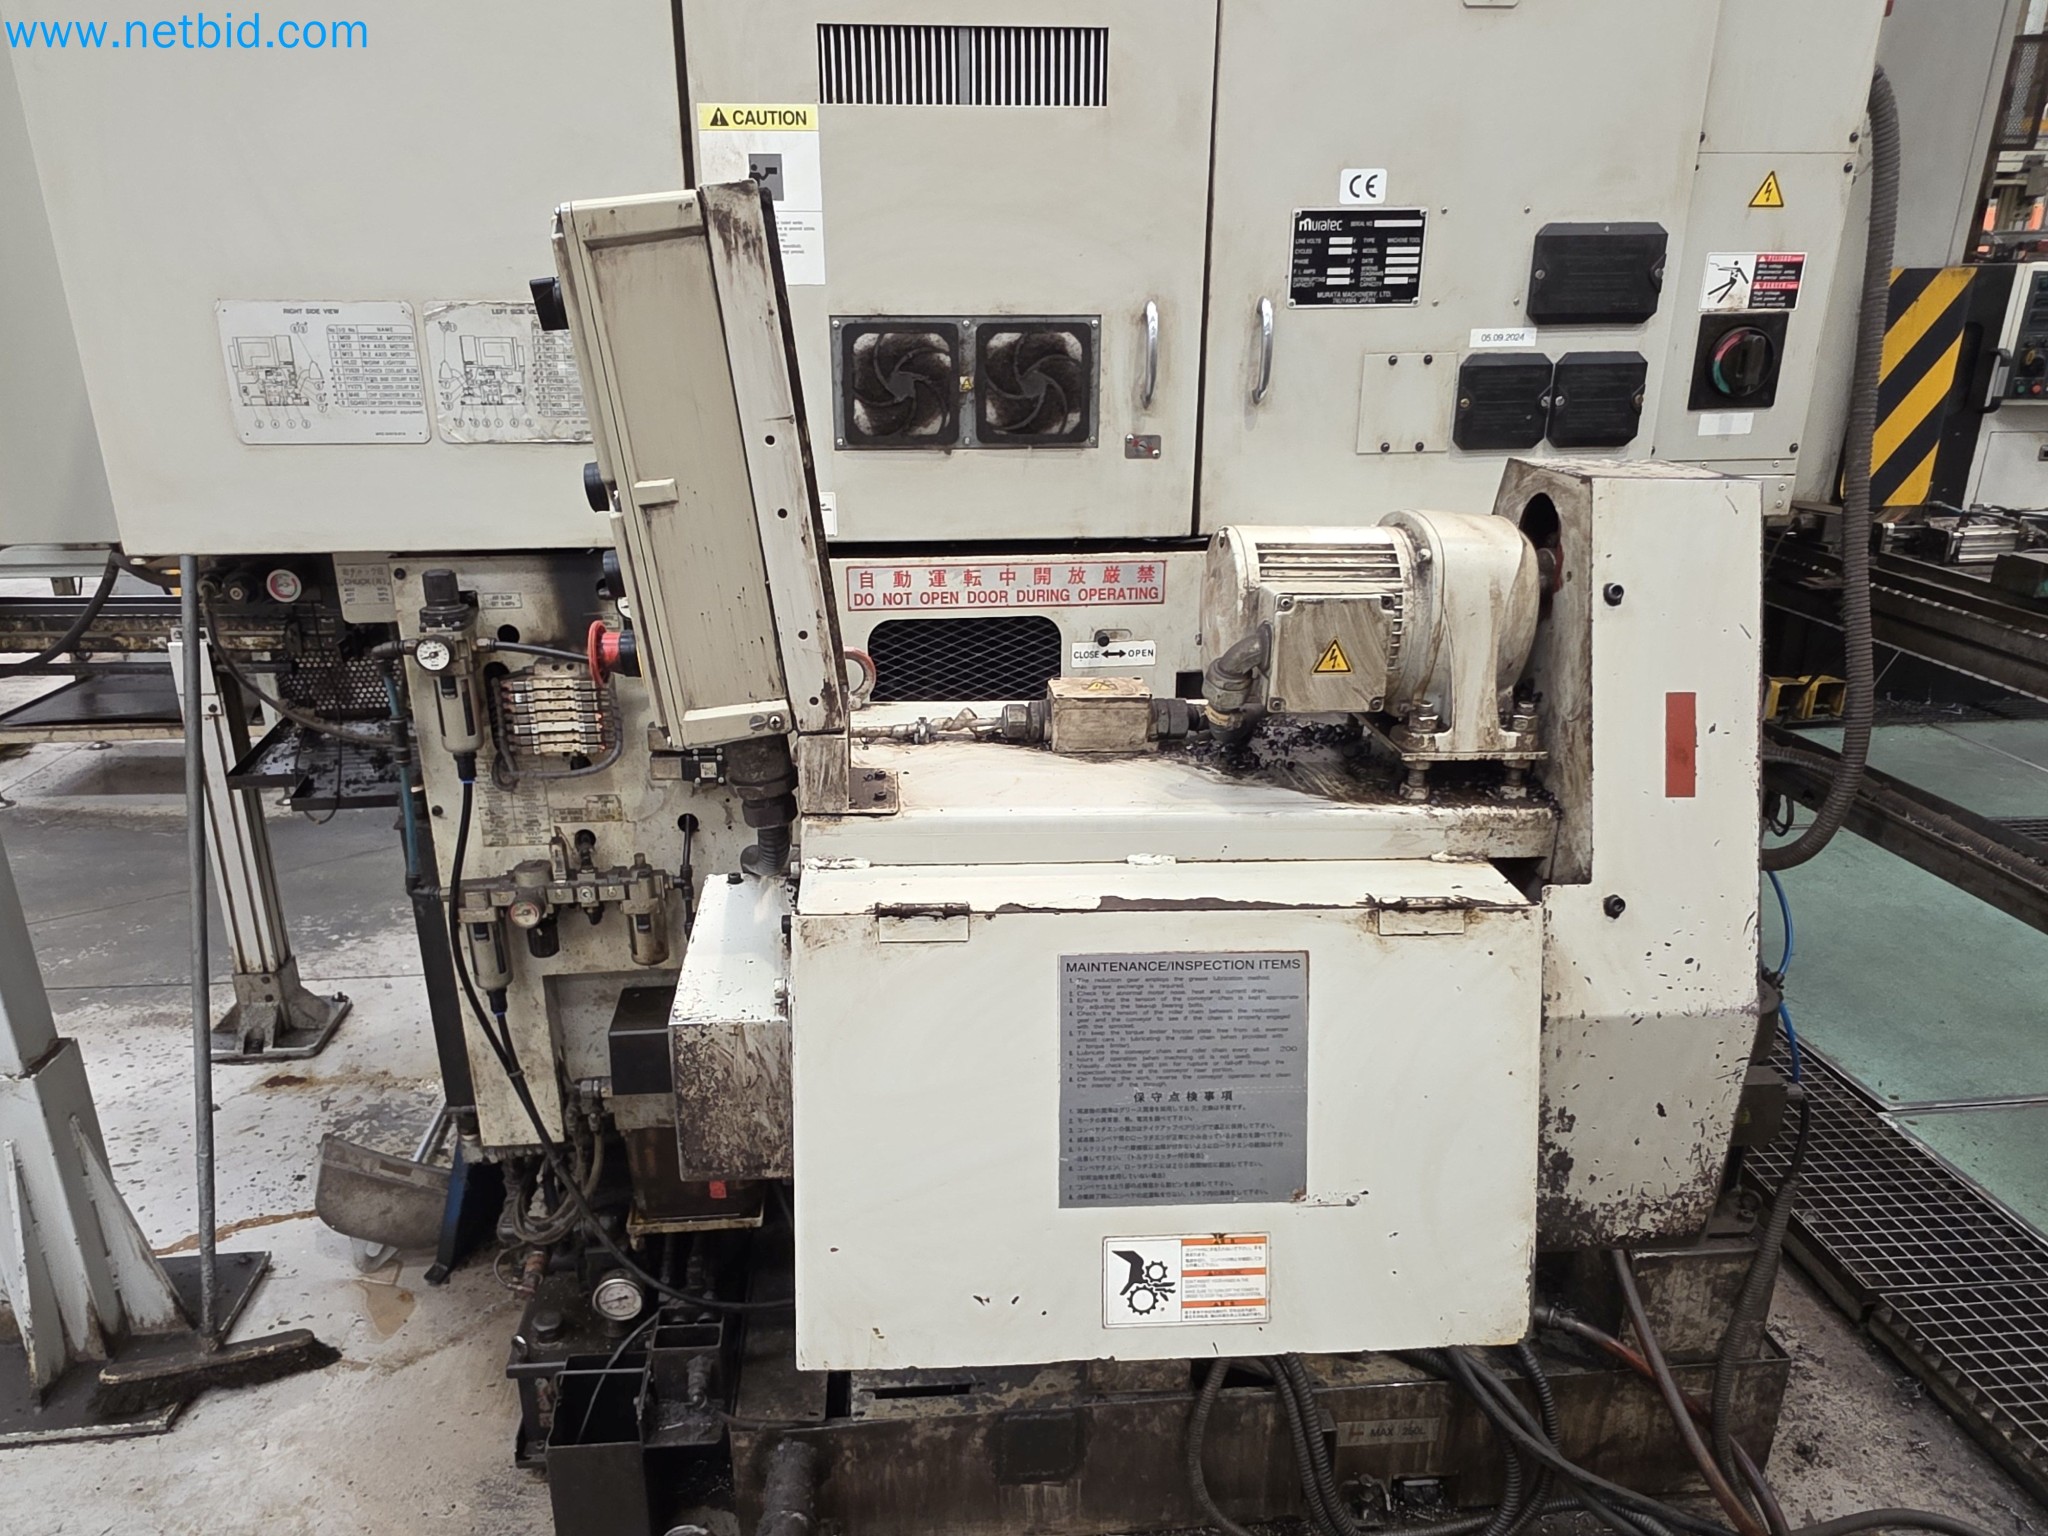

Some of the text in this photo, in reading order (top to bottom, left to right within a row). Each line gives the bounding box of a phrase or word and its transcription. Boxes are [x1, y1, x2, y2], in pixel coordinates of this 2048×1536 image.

[732, 110, 807, 126] CAUTION
[1349, 174, 1378, 198] CE
[860, 564, 1155, 589] 自動運転中開放厳禁
[854, 587, 1159, 606] DO NOT OPEN DOOR DURING OPERATING
[1073, 650, 1100, 659] CLOSE
[1127, 649, 1154, 658] OPEN
[1066, 959, 1301, 972] MAINTENANCE/INSPECTION ITEMS
[1134, 1090, 1233, 1102] 保守点検事項
[1370, 1427, 1393, 1437] MAX
